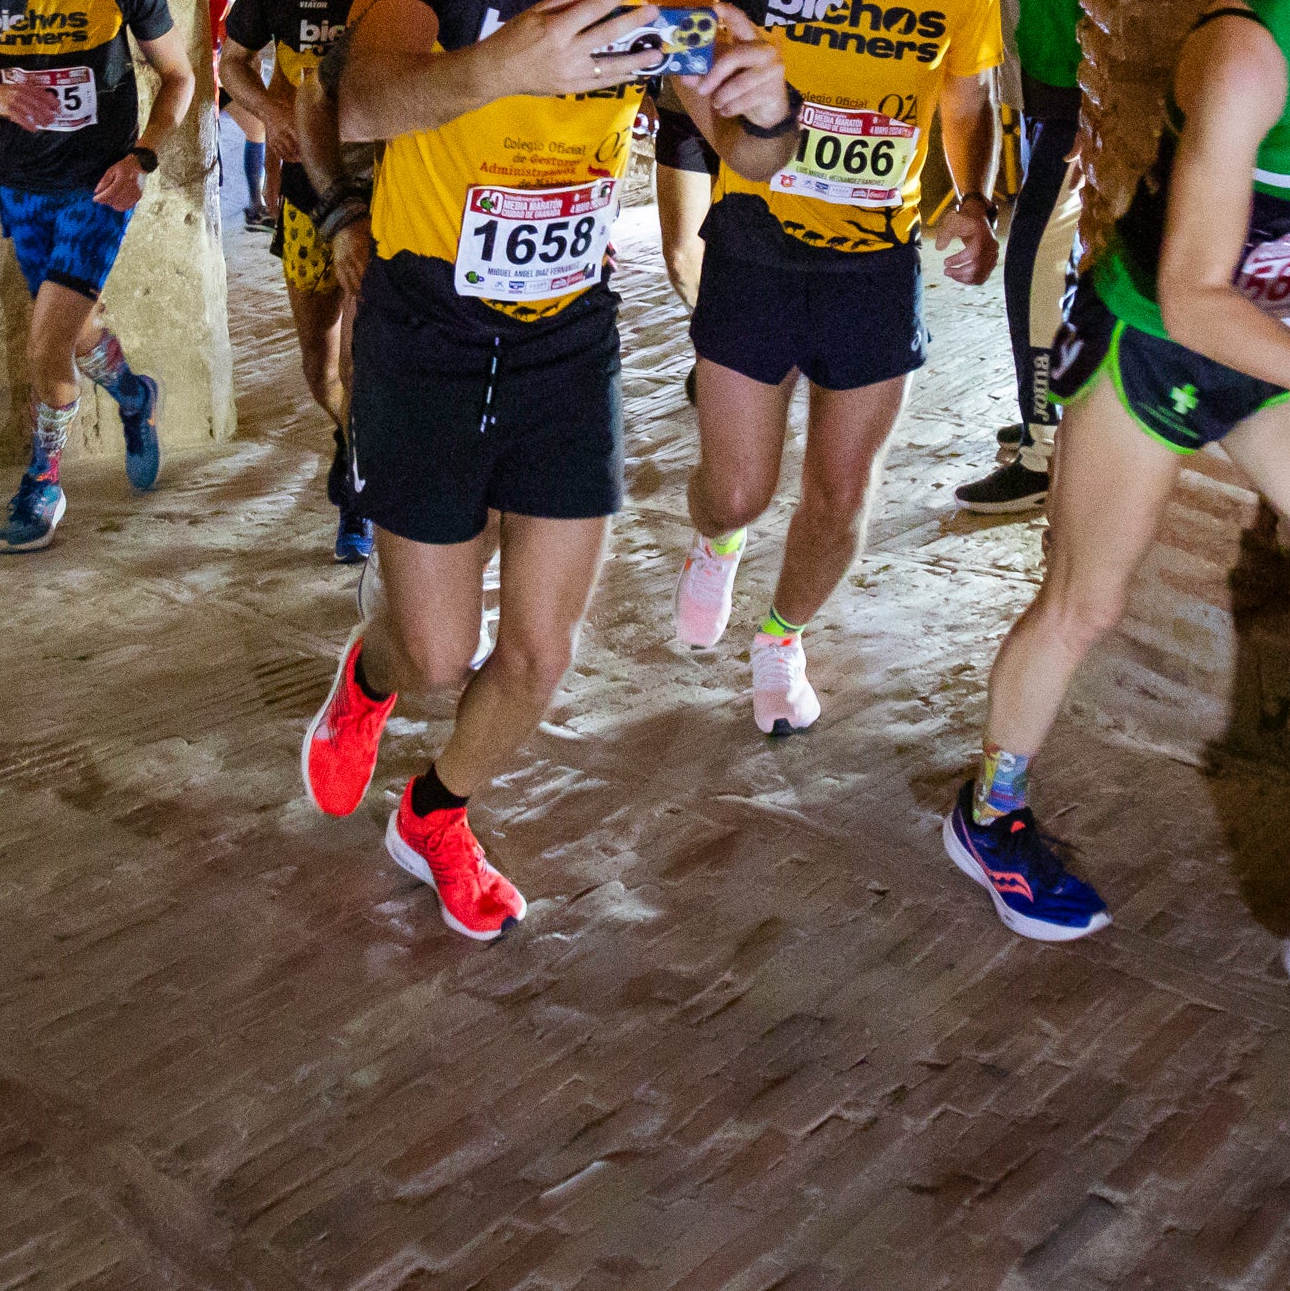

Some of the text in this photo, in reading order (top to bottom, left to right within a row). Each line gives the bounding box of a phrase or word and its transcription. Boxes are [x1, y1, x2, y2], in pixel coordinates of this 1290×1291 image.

[299, 1, 328, 9] VIATOR
[299, 18, 348, 43] bic
[764, 11, 941, 64] runners
[803, 92, 832, 105] olegio
[504, 136, 587, 156] Colegio Oficial
[795, 128, 896, 177] 1066
[473, 216, 596, 266] 1658
[487, 267, 511, 278] MIGUEL
[513, 266, 534, 278] ANGEL
